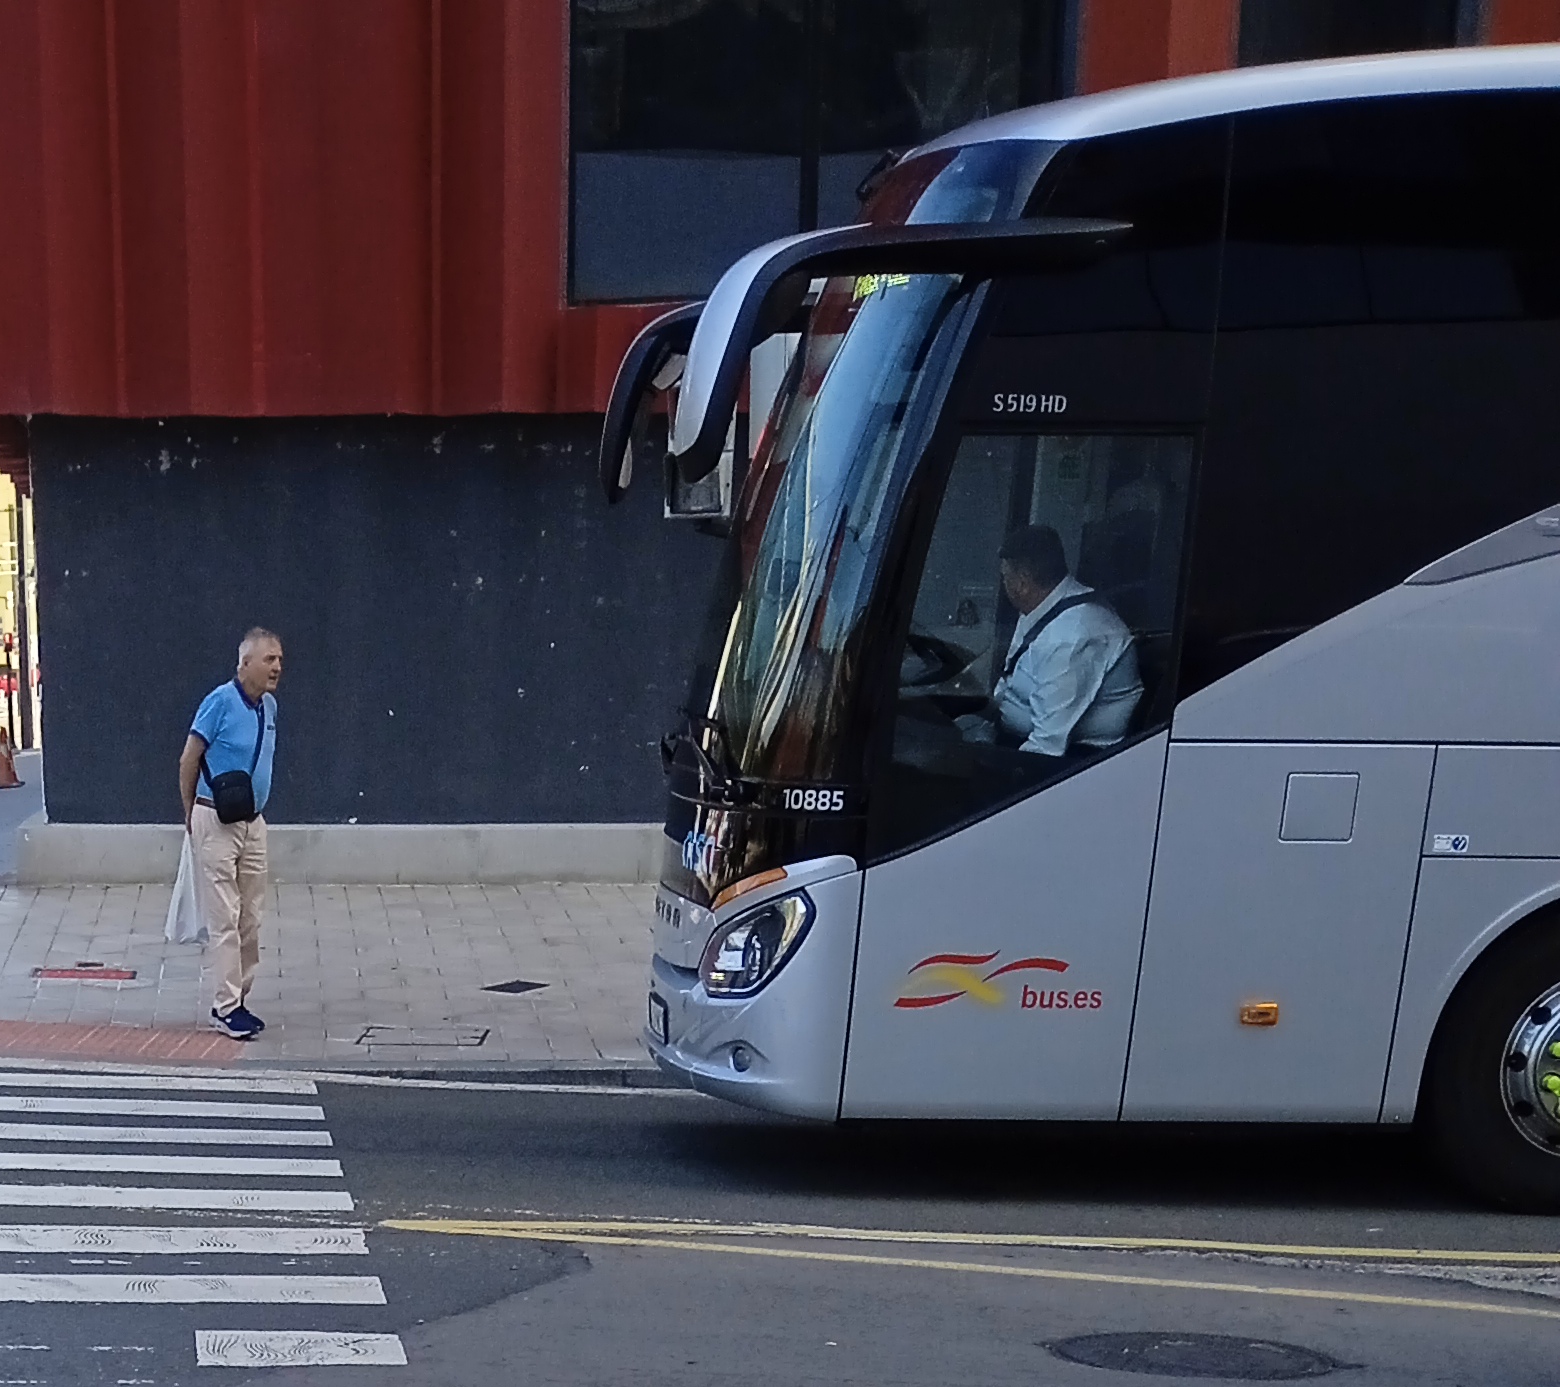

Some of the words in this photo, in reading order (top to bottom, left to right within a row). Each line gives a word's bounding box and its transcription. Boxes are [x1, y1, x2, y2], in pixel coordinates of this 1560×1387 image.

[992, 393, 1004, 412] S
[1007, 393, 1037, 412] 519
[1040, 394, 1067, 413] HD
[783, 788, 845, 812] 10885
[1021, 984, 1102, 1009] bus.es
